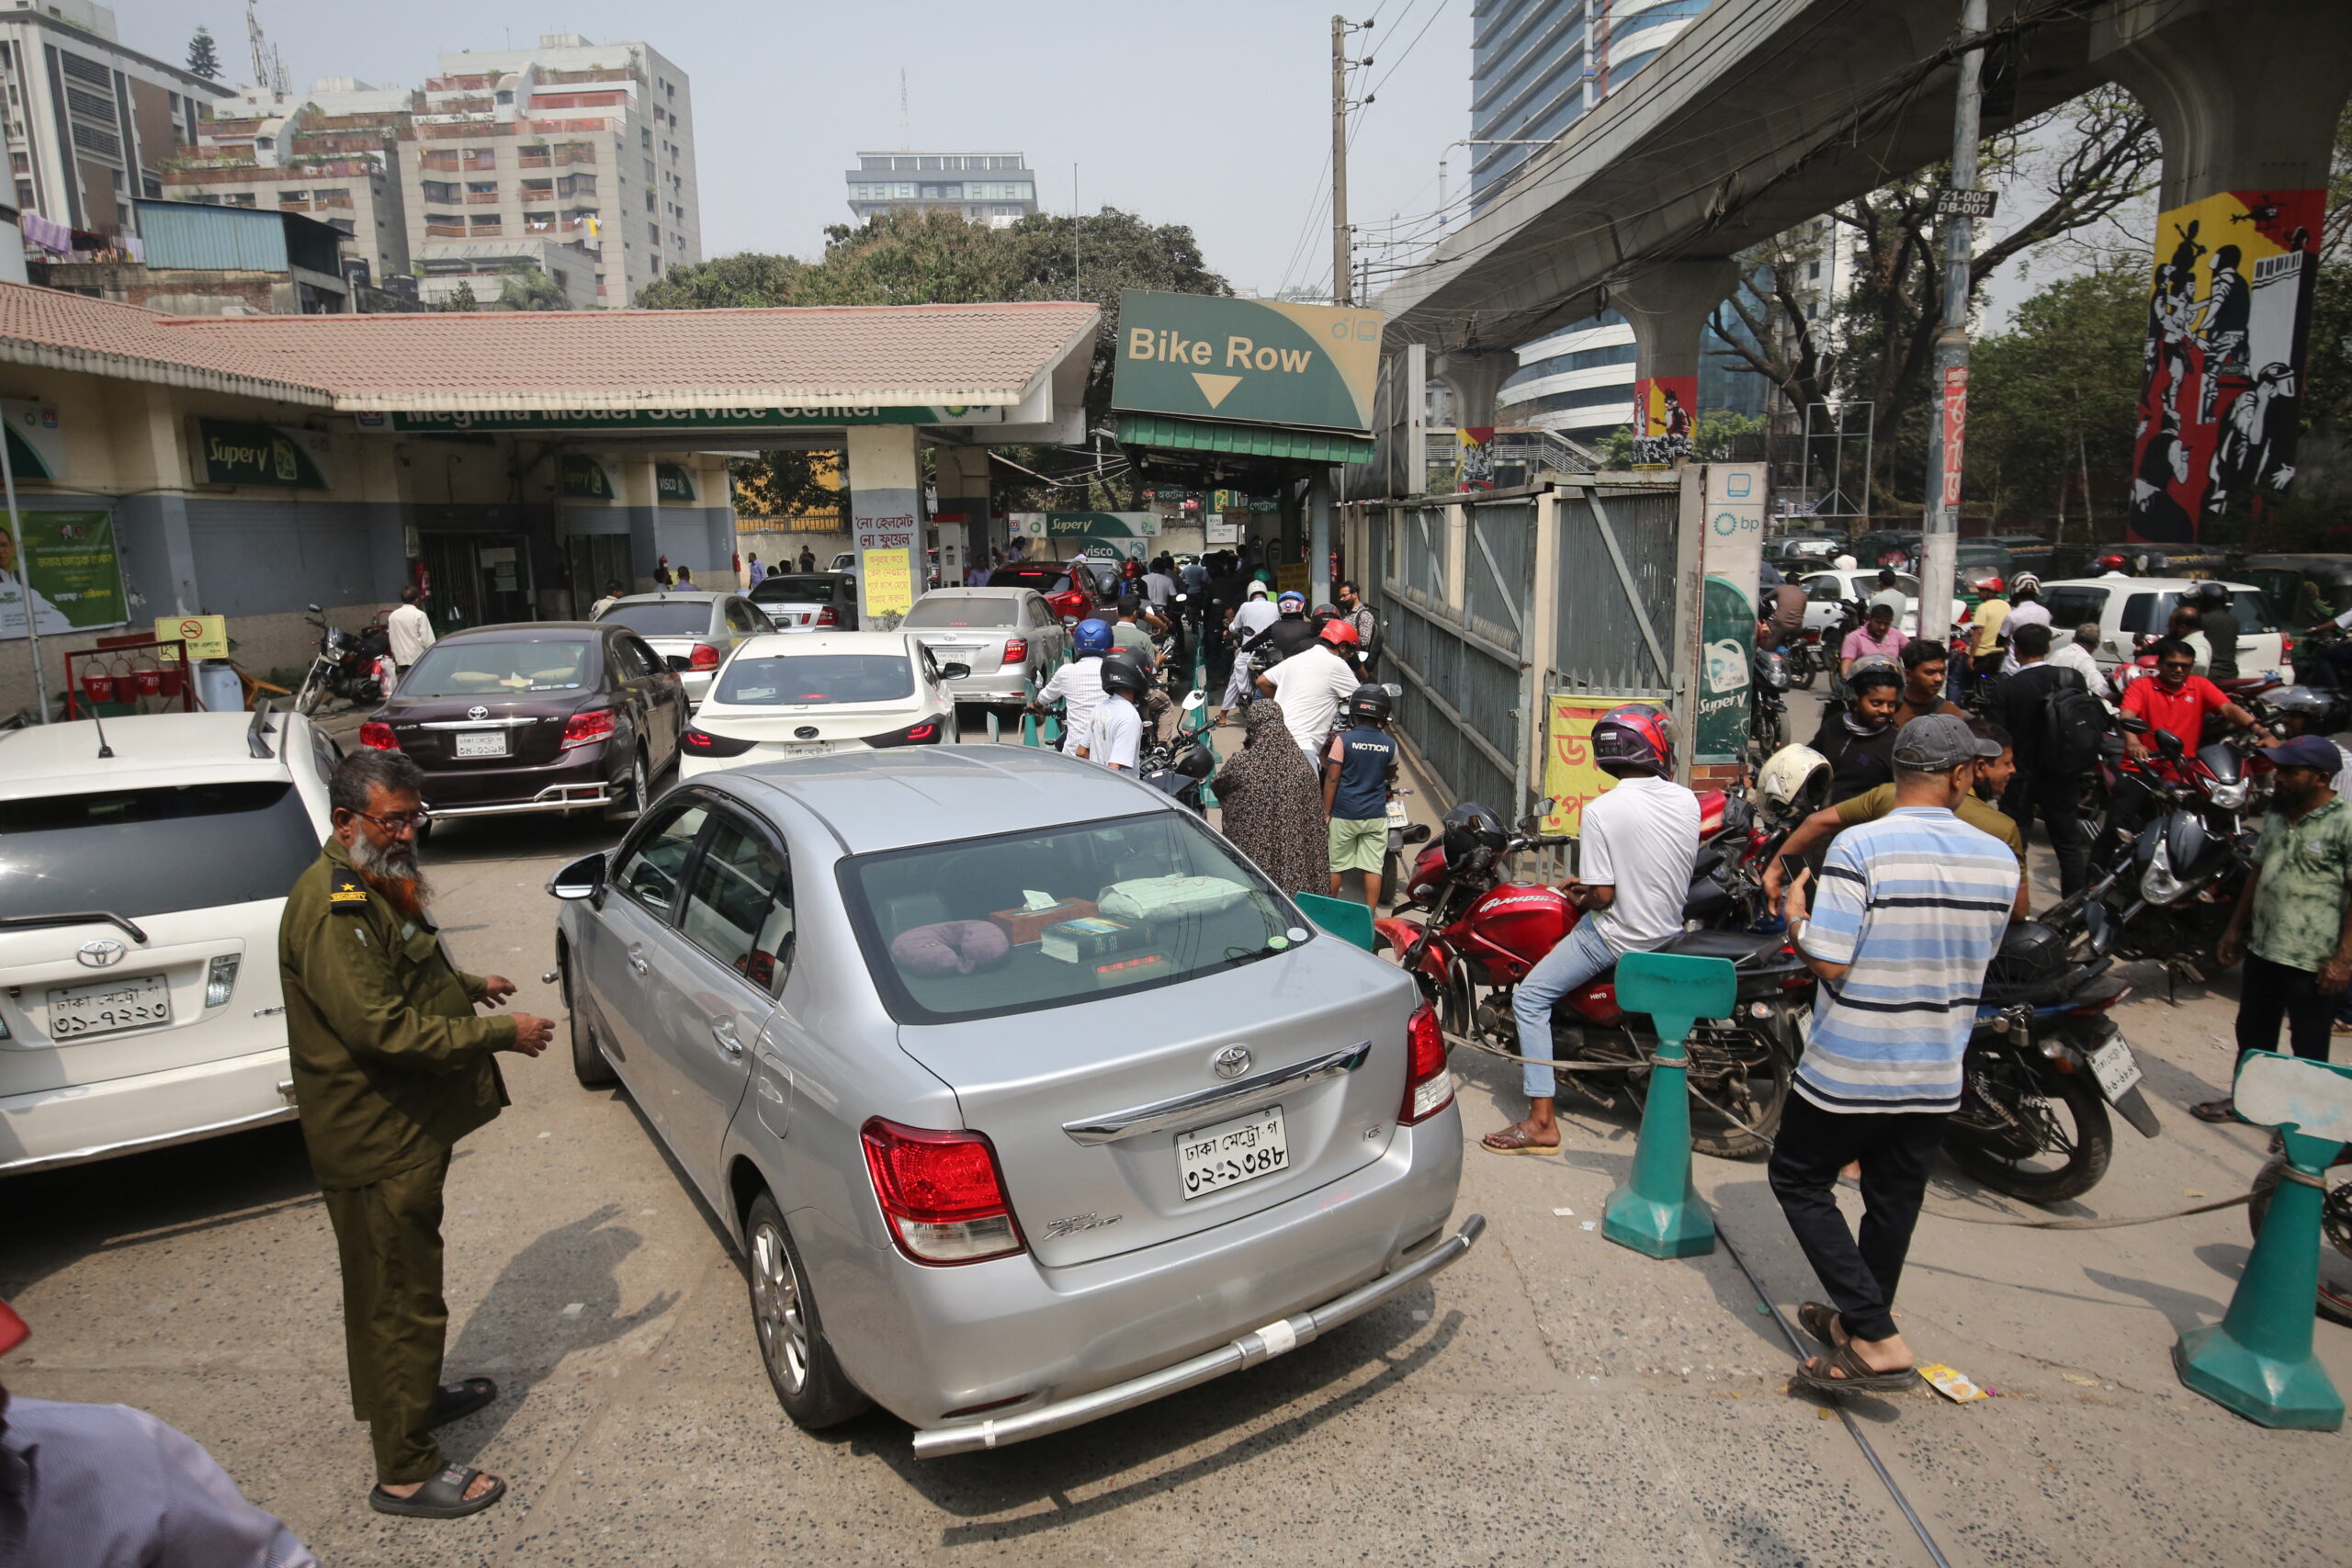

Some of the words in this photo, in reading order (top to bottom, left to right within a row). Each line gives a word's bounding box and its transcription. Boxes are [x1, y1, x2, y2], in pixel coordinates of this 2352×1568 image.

[1939, 190, 1990, 203] Z1-004
[1937, 202, 1990, 215] DB-007
[1128, 327, 1213, 366] Bike
[1226, 335, 1313, 374] Row
[876, 513, 915, 530] হেলমেট
[1740, 516, 1759, 533] bp
[860, 534, 875, 546] নো
[1351, 742, 1389, 752] MOTION
[1185, 1139, 1217, 1161] ঢাকা
[1184, 1146, 1285, 1192] ৩২-১৩৪৮
